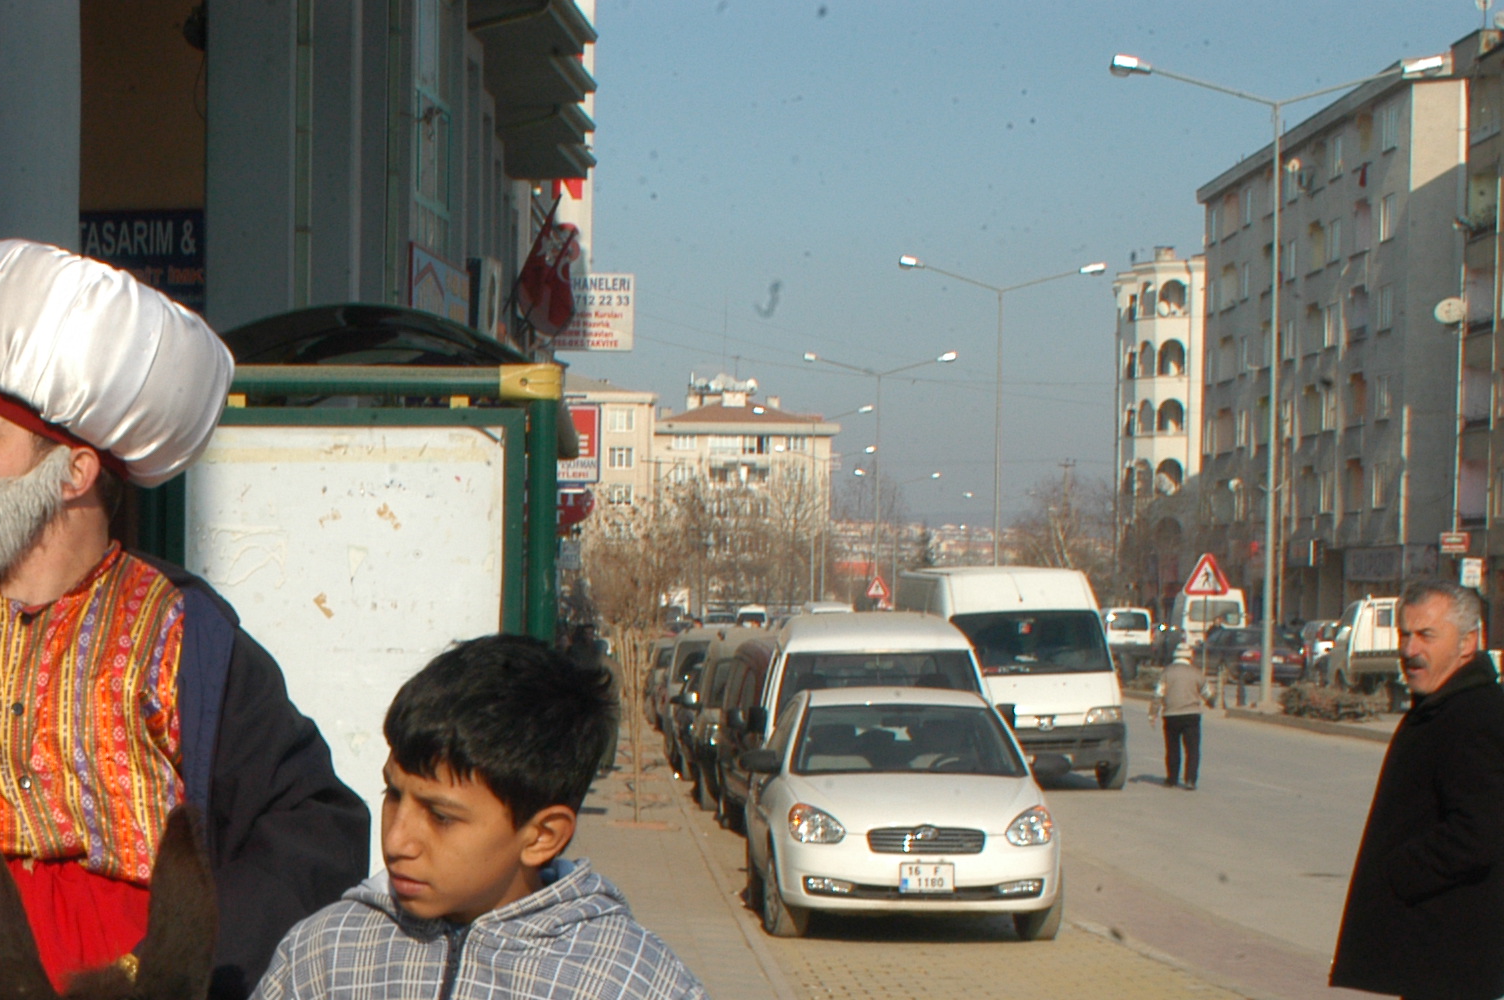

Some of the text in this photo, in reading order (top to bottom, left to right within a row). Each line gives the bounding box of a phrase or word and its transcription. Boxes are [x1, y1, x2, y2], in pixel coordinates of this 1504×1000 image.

[179, 218, 197, 256] &
[908, 866, 921, 876] 16
[917, 877, 944, 888] 1180
